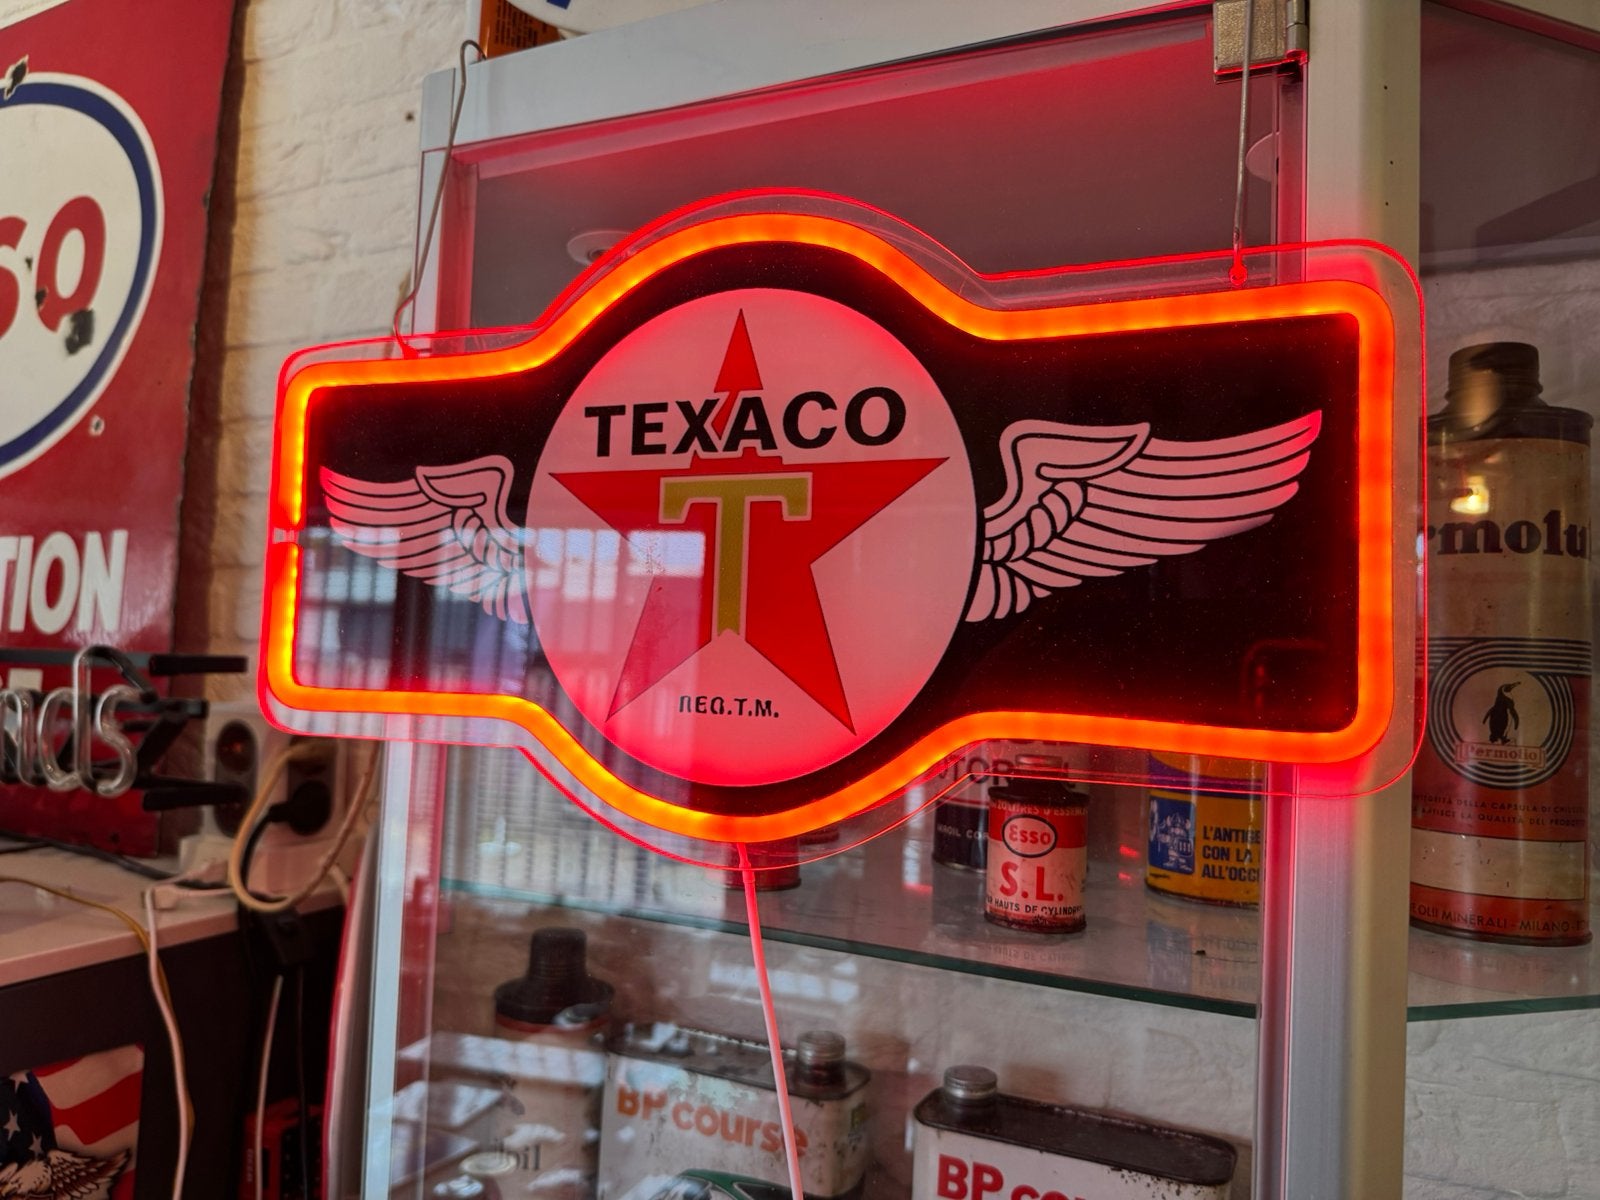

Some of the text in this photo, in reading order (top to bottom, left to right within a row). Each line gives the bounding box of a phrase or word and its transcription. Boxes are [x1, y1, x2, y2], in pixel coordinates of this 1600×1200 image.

[585, 386, 906, 457] TEXACO
[660, 474, 811, 638] T
[1202, 845, 1253, 863] CON LA
[1000, 861, 1064, 901] S.L.
[995, 897, 1020, 911] HAUTS
[1441, 909, 1508, 929] MINERALI
[1520, 919, 1570, 932] MILANO
[937, 1154, 1004, 1200] BP
